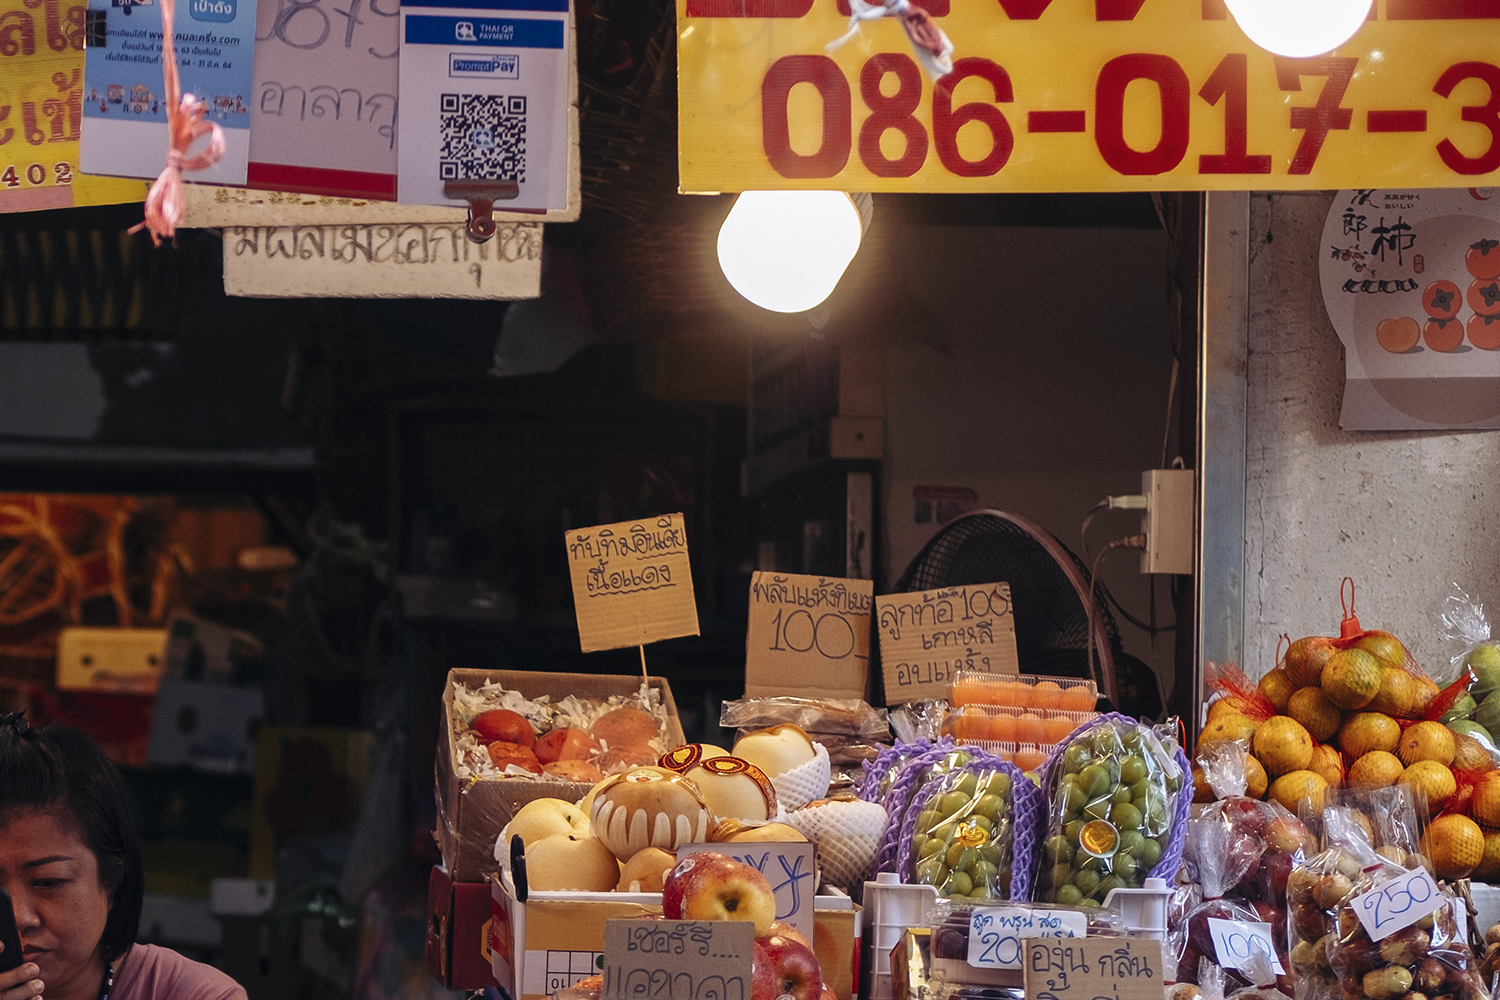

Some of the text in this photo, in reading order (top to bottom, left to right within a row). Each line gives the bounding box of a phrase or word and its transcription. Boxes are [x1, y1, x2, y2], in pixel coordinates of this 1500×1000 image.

[149, 30, 240, 46] ww.คนละครึ่ง.com
[479, 32, 514, 41] PAYMENT
[480, 24, 514, 33] THAI QR
[586, 558, 671, 592] เนื้อแดง
[880, 594, 954, 640] ลูกท้อ
[921, 618, 994, 651] เกาหลี
[978, 931, 1022, 965] 20
[1031, 939, 1153, 987] องุ่น กลิ่น
